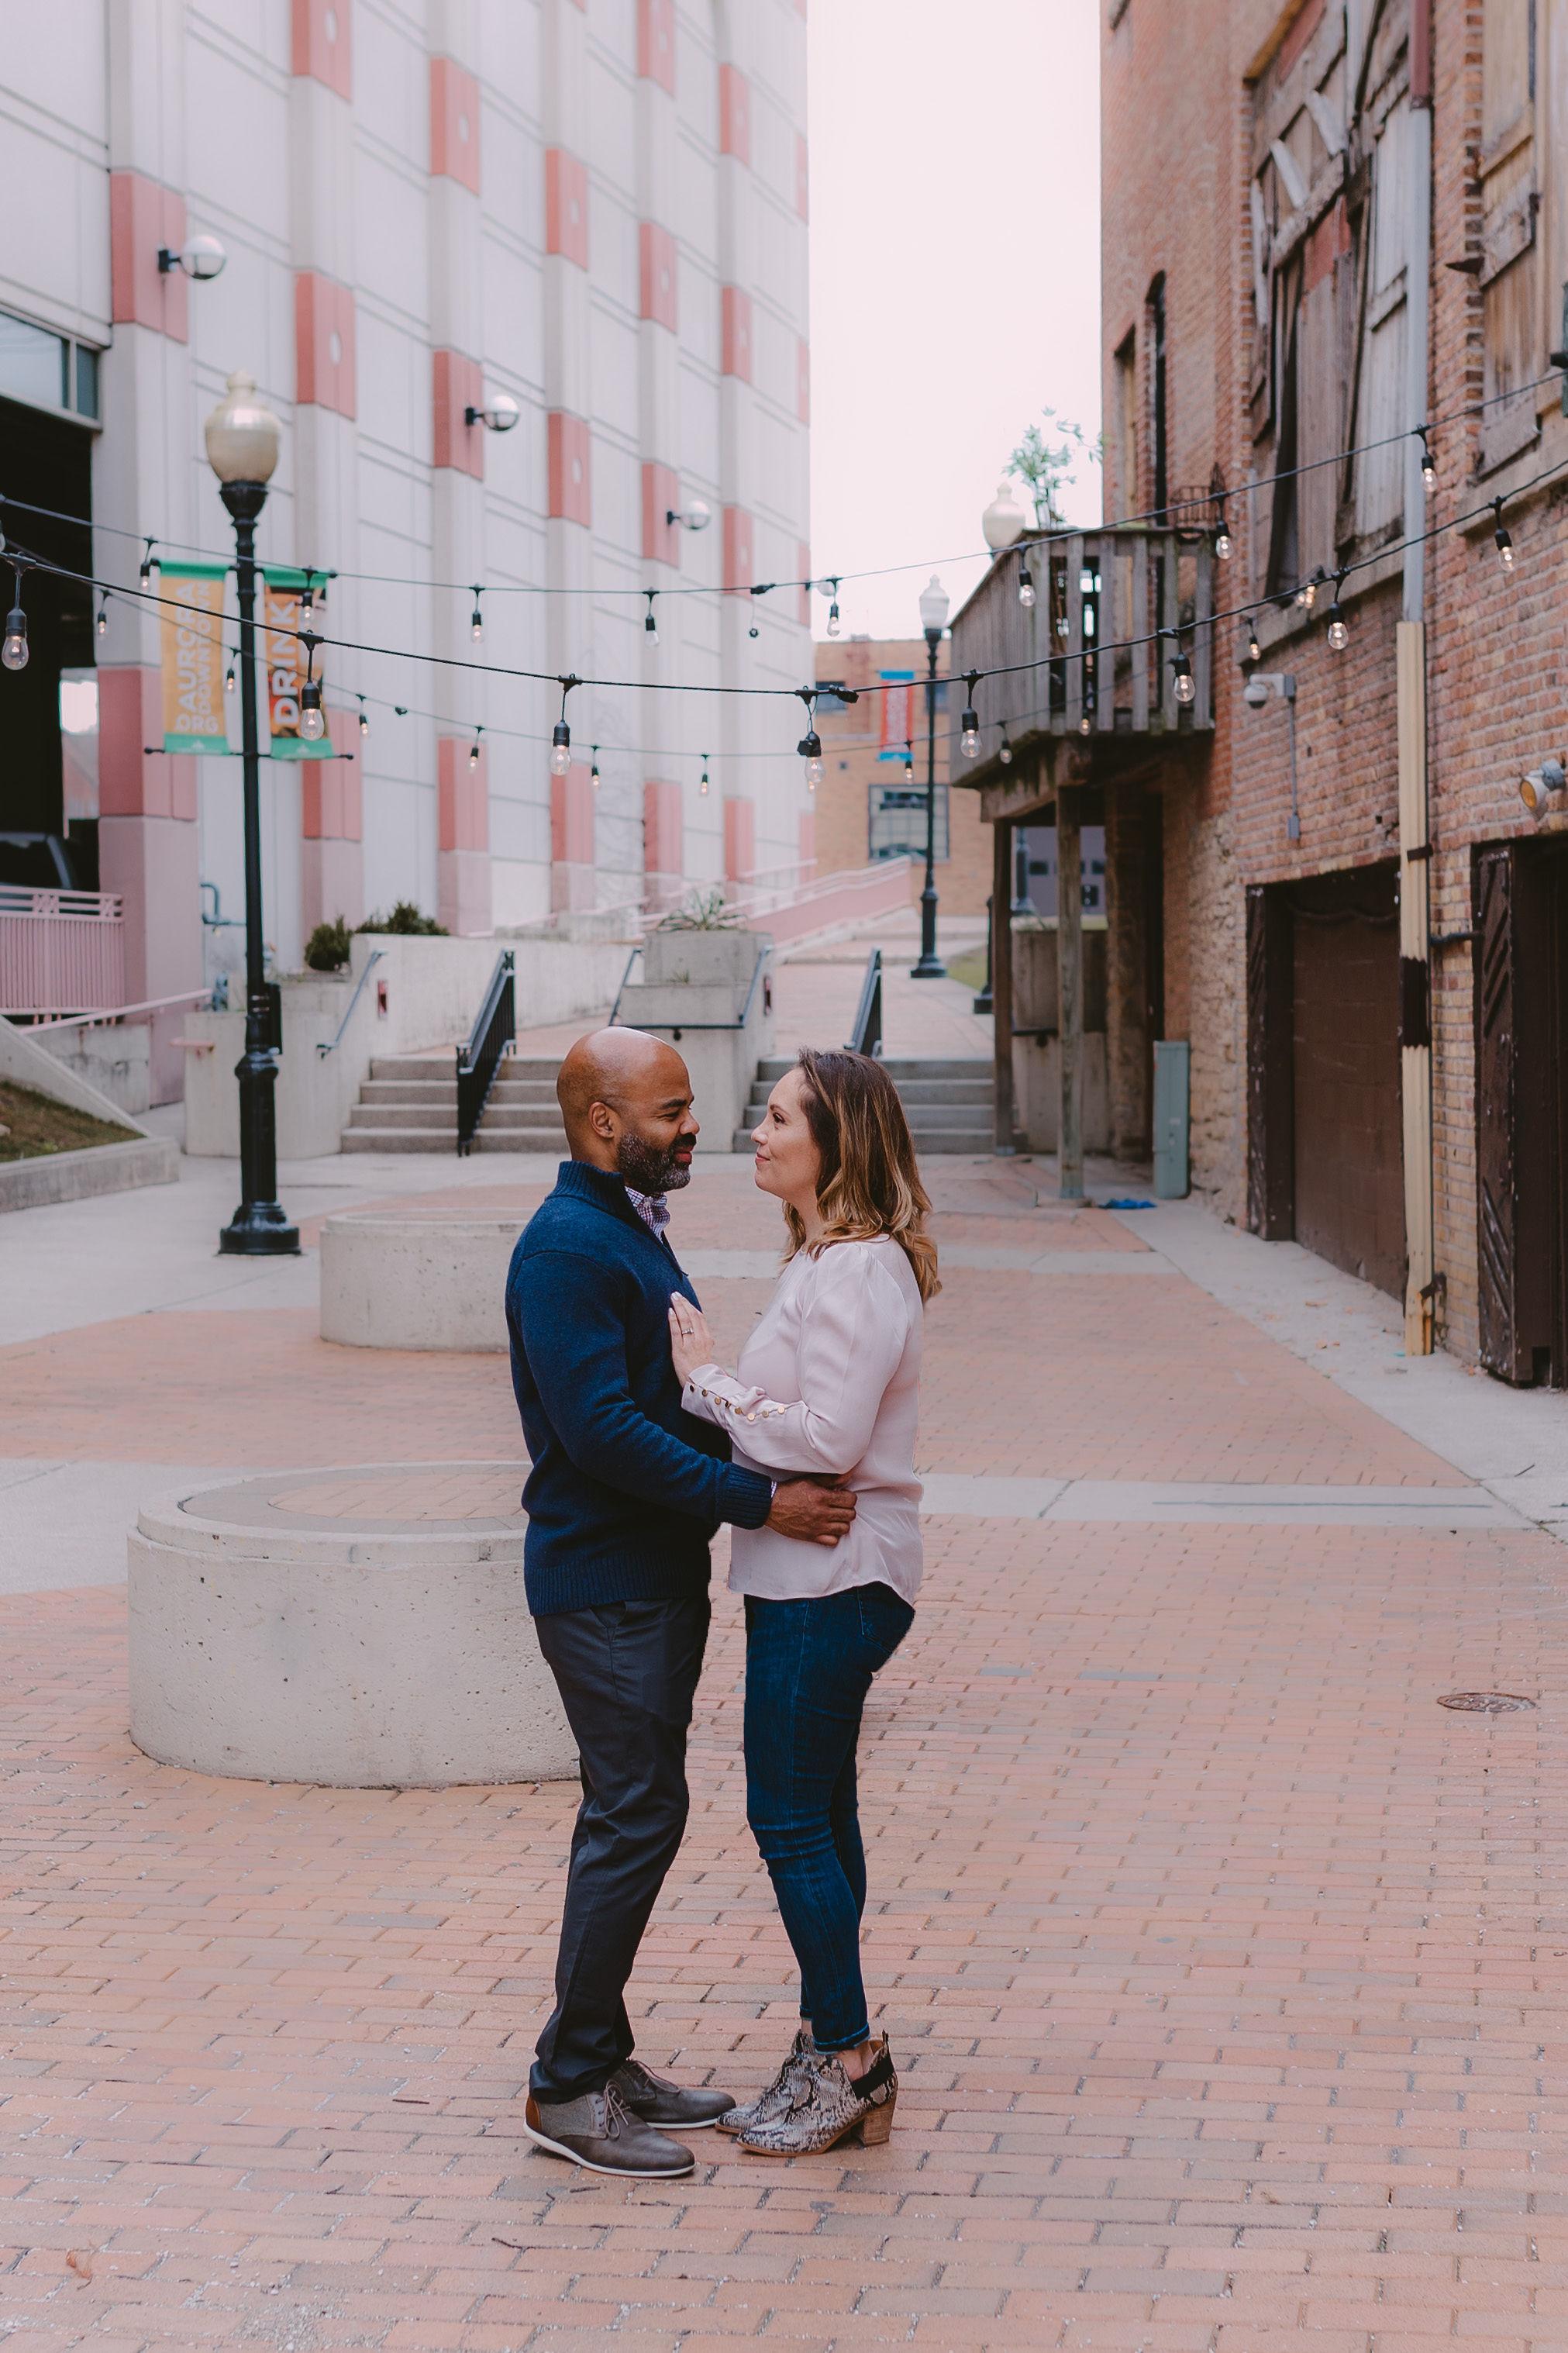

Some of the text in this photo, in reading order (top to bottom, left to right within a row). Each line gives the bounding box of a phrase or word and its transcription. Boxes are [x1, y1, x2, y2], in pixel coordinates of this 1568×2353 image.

[177, 584, 197, 711] AURORA
[196, 583, 212, 713] DOWNTOWN
[271, 602, 300, 725] DRINK
